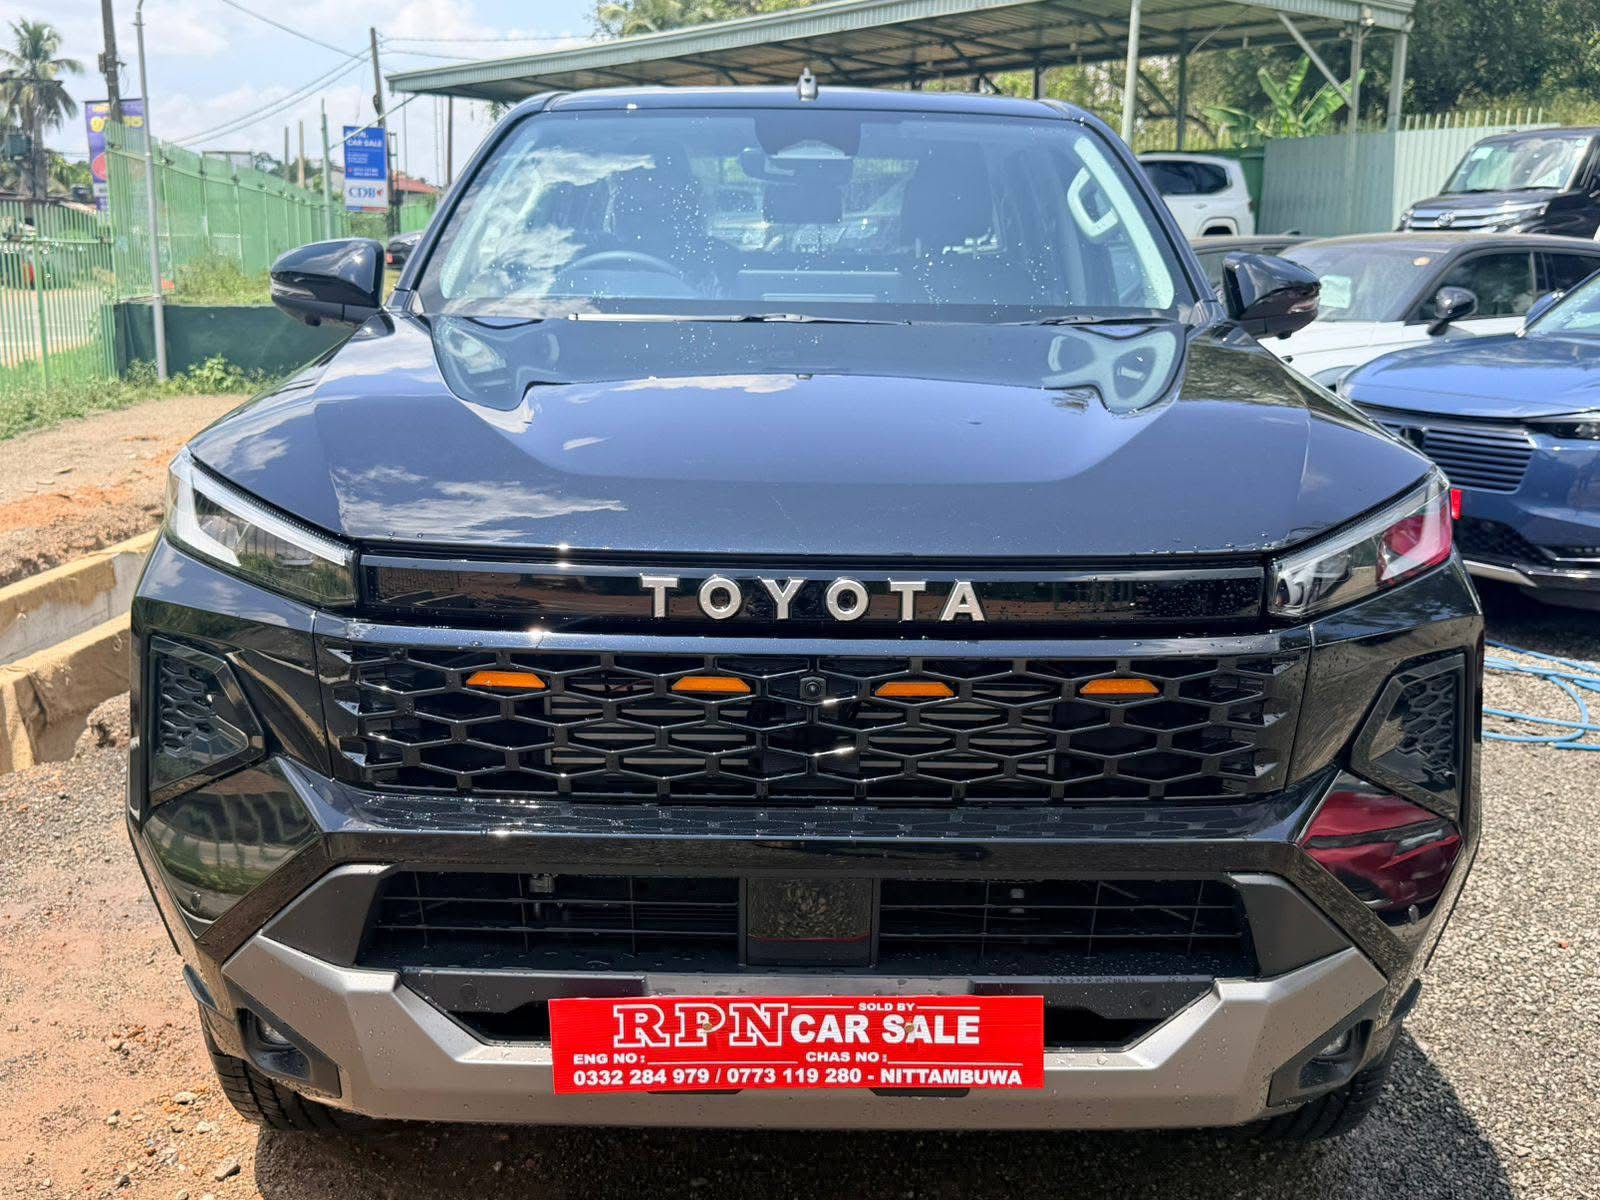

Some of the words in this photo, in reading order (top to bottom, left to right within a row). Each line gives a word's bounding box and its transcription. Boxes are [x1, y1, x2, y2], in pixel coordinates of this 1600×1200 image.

[349, 186, 376, 199] CDB
[640, 574, 986, 622] TOYOTA
[858, 1003, 893, 1011] SOLD
[897, 1003, 915, 1011] BY
[613, 1003, 789, 1048] RPN
[790, 1014, 870, 1044] CAR
[882, 1014, 980, 1044] SALE
[573, 1053, 608, 1065] ENG
[805, 1052, 851, 1063] CHAS
[573, 1069, 624, 1086] 0332
[629, 1069, 667, 1085] 284
[672, 1068, 710, 1084] 979
[715, 1068, 721, 1084] /
[726, 1068, 776, 1084] 0773
[783, 1068, 818, 1083] 119
[825, 1068, 862, 1083] 280
[880, 1068, 1022, 1085] NITTAMBUWA
